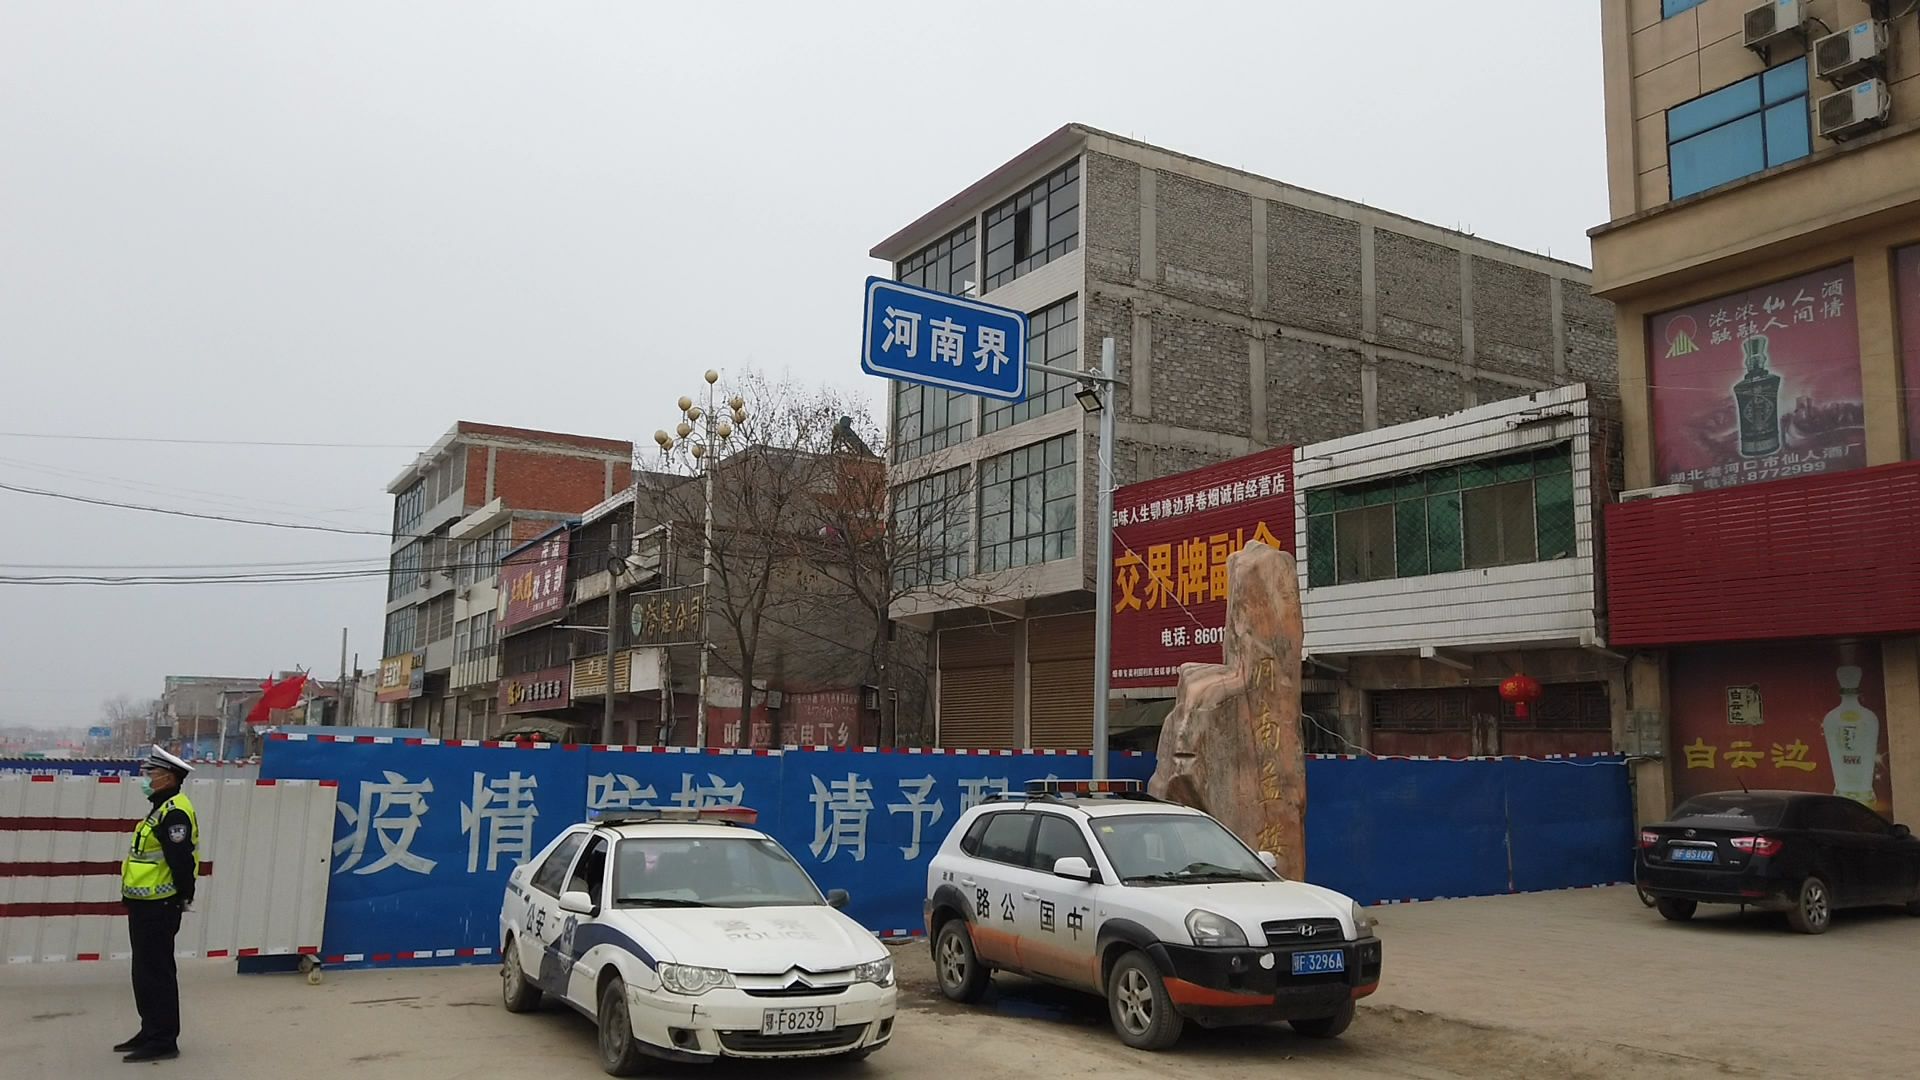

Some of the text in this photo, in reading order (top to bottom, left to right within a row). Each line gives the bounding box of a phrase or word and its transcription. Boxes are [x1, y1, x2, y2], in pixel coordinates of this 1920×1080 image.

[881, 305, 1010, 376] 河南界
[1670, 443, 1861, 484] 湖北老河口市仙人酒厂
[1114, 521, 1281, 614] 交界牌副
[1683, 737, 1817, 772] 白云边
[526, 903, 547, 940] 公安
